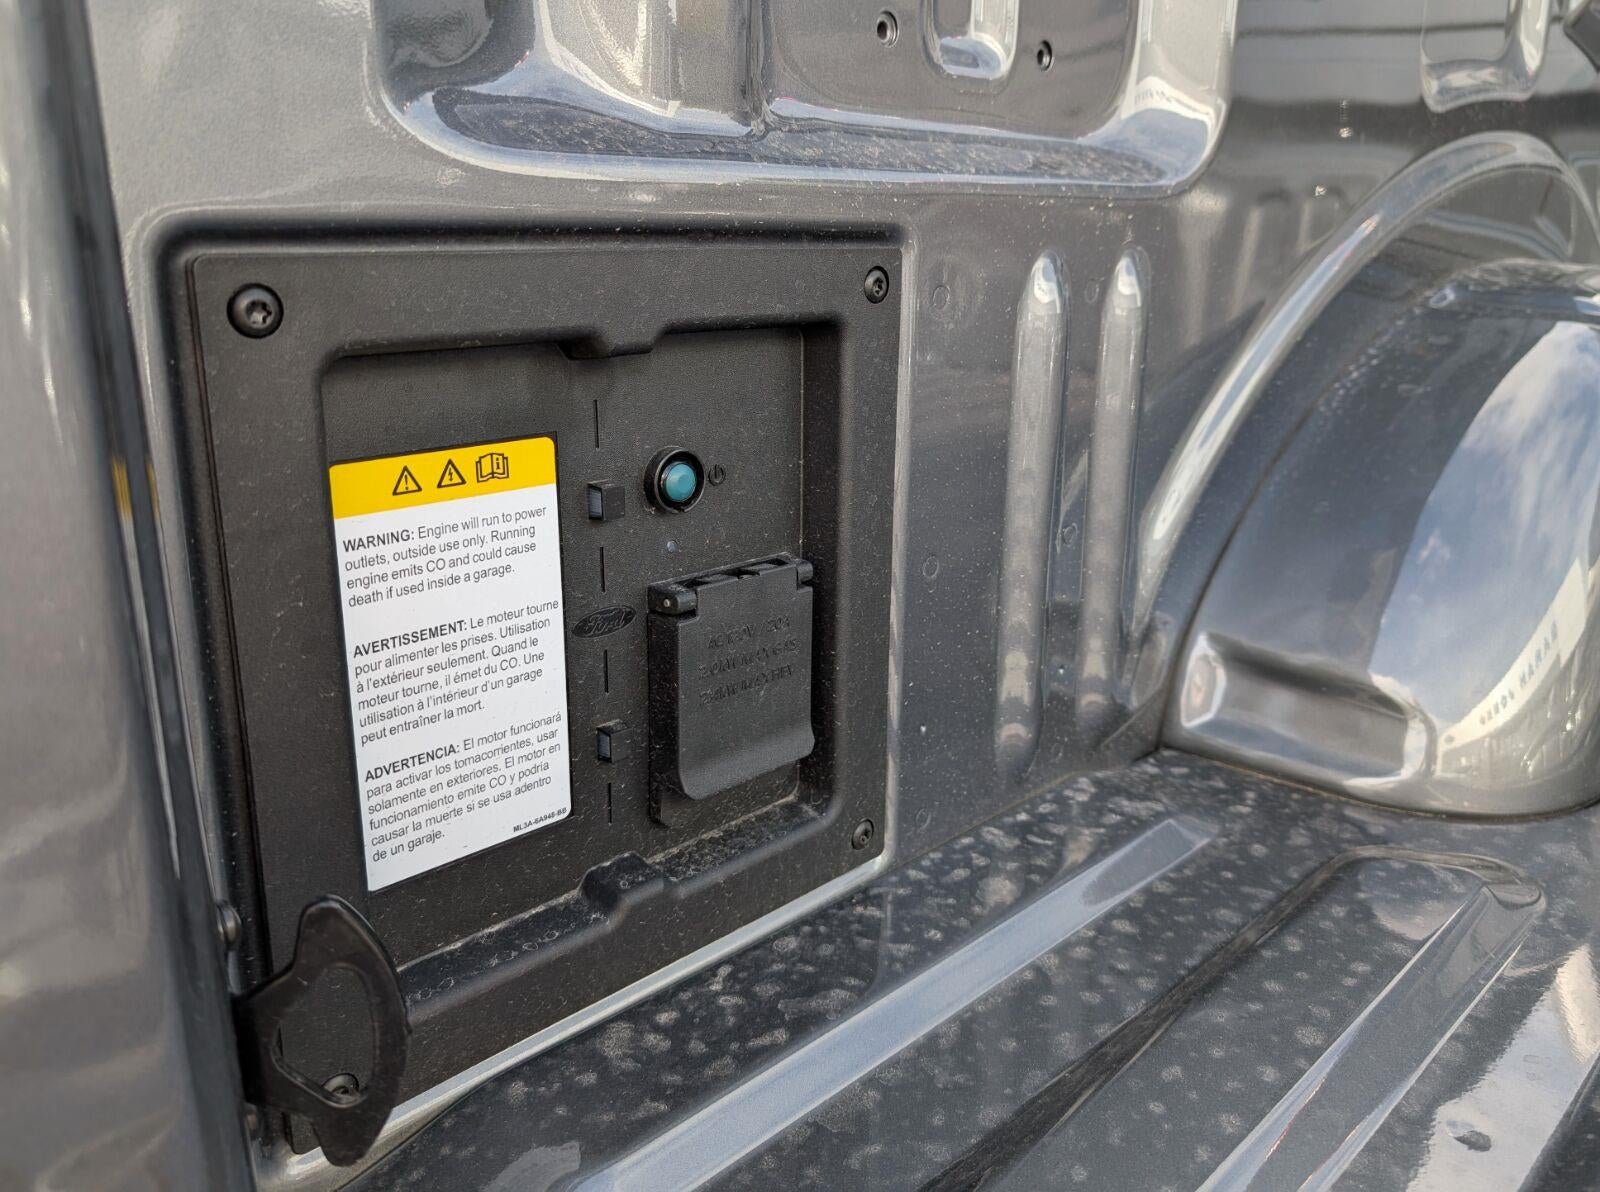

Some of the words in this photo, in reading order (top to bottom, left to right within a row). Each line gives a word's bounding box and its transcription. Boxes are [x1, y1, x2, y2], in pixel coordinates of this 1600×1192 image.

[342, 528, 415, 553] WARNING:
[417, 522, 459, 540] Engine
[460, 516, 479, 531] will
[481, 515, 500, 527] run
[501, 512, 513, 524] to
[514, 506, 547, 524] power
[344, 553, 390, 572] outlets,
[392, 543, 437, 562] outside
[438, 540, 460, 553] use
[462, 533, 488, 549] only.
[490, 525, 536, 543] Running
[346, 571, 389, 590] engine
[391, 563, 424, 580] emits
[425, 557, 446, 573] CO
[448, 552, 470, 569] and
[472, 546, 502, 564] could
[504, 542, 537, 557] cause
[348, 589, 384, 608] death
[385, 585, 394, 600] if
[395, 579, 425, 598] used
[426, 573, 462, 591] inside
[463, 572, 471, 583] a
[472, 564, 515, 584] garage.
[353, 619, 468, 659] AVERTISSEMENT:
[470, 617, 484, 630] Le
[486, 607, 525, 625] moteur
[526, 600, 559, 616] tourne
[354, 659, 383, 679] pour
[384, 645, 440, 669] alimenter
[441, 641, 458, 654] les
[460, 632, 497, 652] prises.
[499, 618, 551, 639] Utilisation
[582, 608, 627, 637] Ford
[356, 680, 364, 694] à
[426, 648, 489, 674] seulement.
[491, 637, 528, 657] Quand
[529, 636, 539, 648] le
[358, 690, 400, 711] moteur
[401, 680, 443, 698] tourne,
[444, 674, 451, 687] il
[453, 666, 482, 684] émet
[483, 663, 498, 676] du
[499, 656, 521, 672] CO.
[523, 651, 545, 665] Une
[359, 703, 415, 728] utilisation
[416, 698, 425, 711] à
[506, 668, 543, 689] garage
[360, 726, 388, 748] peut
[389, 712, 442, 736] entraîner
[443, 708, 455, 720] la
[455, 699, 485, 717] mort.
[364, 743, 460, 783] ADVERTENCIA:
[463, 737, 475, 751] El
[477, 729, 508, 747] motor
[510, 710, 562, 737] funcionará
[366, 782, 393, 802] para
[395, 769, 433, 789] activar
[435, 763, 452, 776] los
[454, 737, 534, 770] tomacorrientes,
[536, 728, 559, 744] usar
[367, 787, 427, 815] solamente
[429, 781, 444, 794] en
[446, 763, 502, 789] exteriores.
[504, 755, 515, 769] El
[517, 747, 547, 765] motor
[547, 743, 561, 754] en
[369, 794, 455, 831] funcionamiento
[457, 783, 486, 801] emite
[488, 774, 507, 789] CO
[509, 772, 516, 786] y
[371, 825, 410, 847] causar
[412, 820, 423, 832] la
[425, 806, 464, 828] muerte
[477, 797, 490, 809] se
[493, 789, 512, 804] usa
[514, 776, 552, 796] adentro
[372, 849, 388, 863] de
[390, 843, 405, 856] un
[407, 829, 445, 853] garaje.
